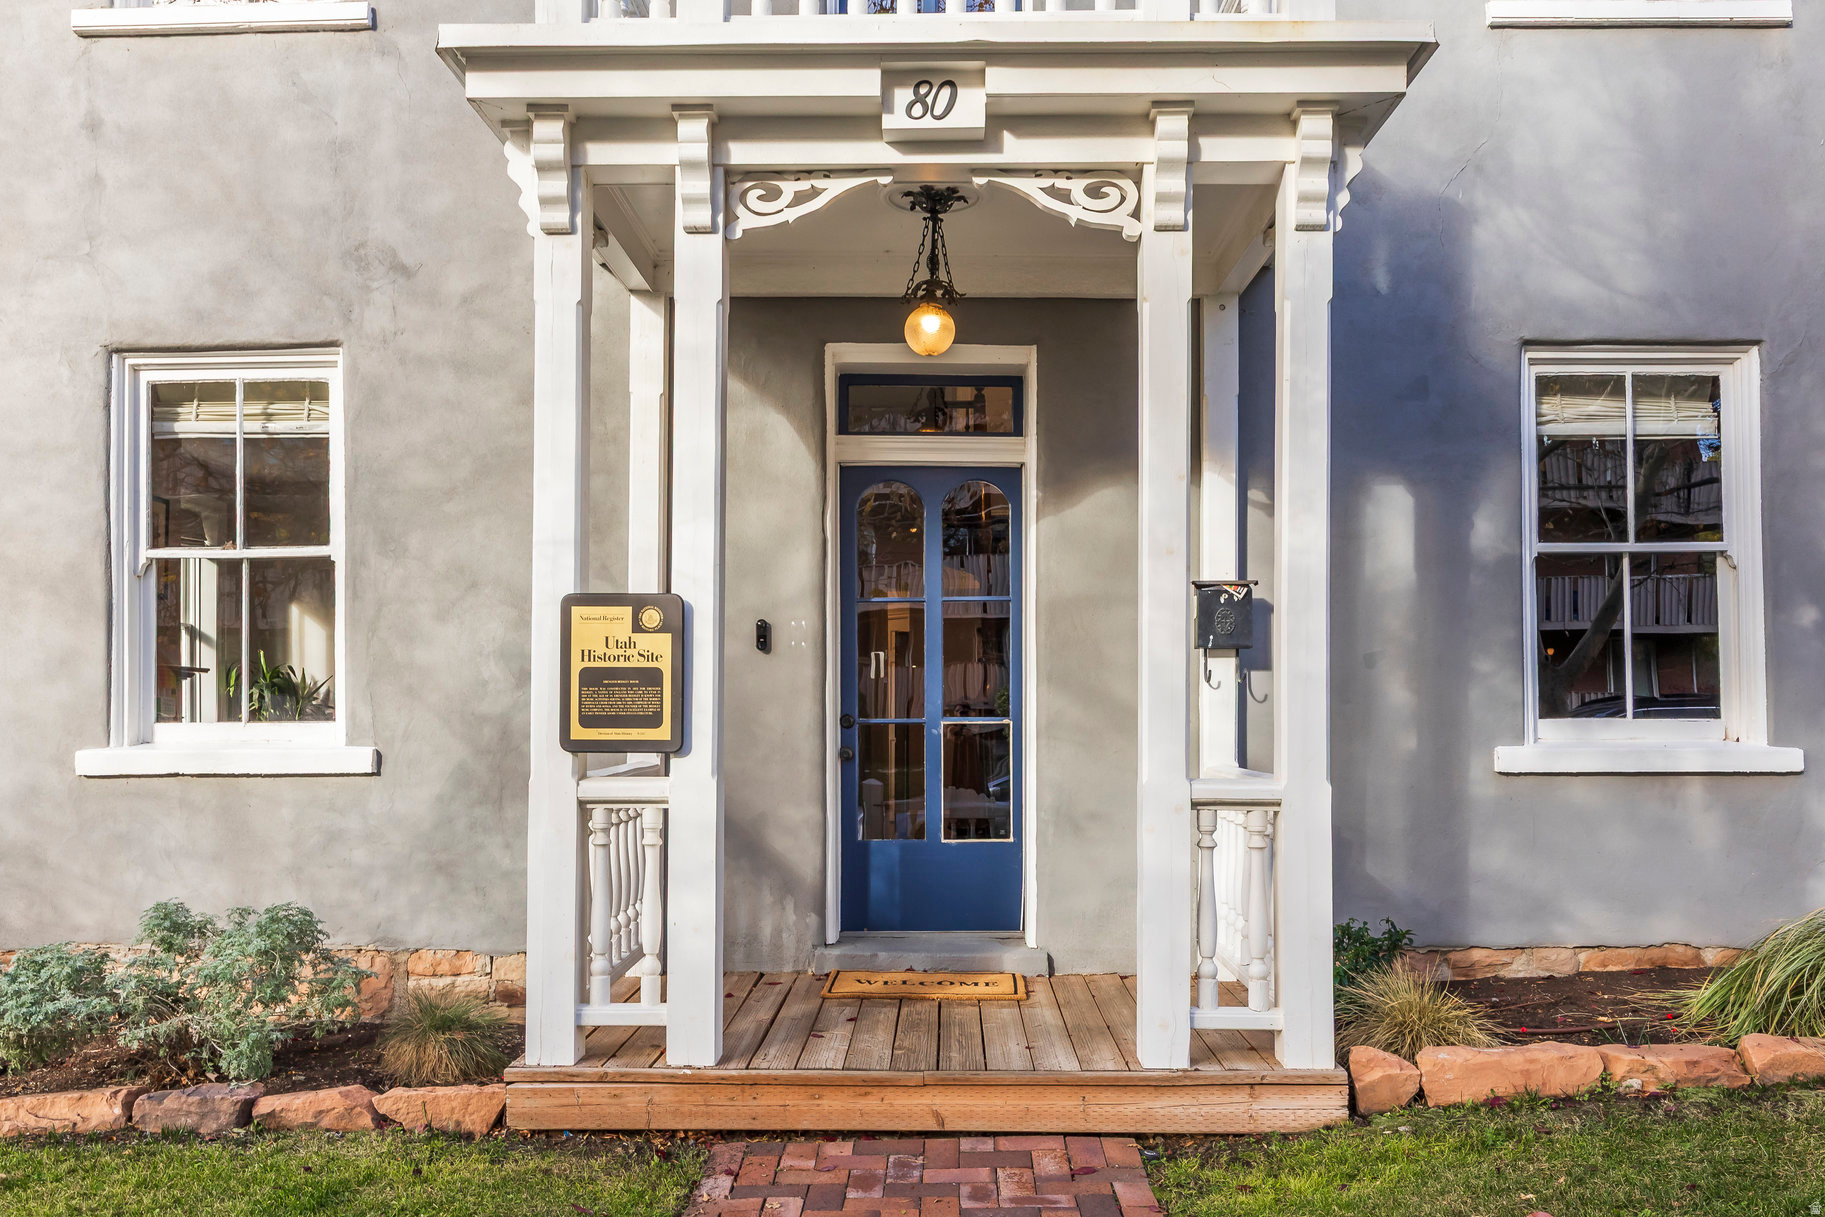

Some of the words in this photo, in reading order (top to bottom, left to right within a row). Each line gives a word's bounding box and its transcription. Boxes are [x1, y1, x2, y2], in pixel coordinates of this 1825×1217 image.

[905, 79, 958, 120] 80
[604, 635, 637, 649] Utah
[580, 649, 635, 663] Historic
[637, 649, 664, 663] Site
[855, 978, 1000, 988] WELCOME
